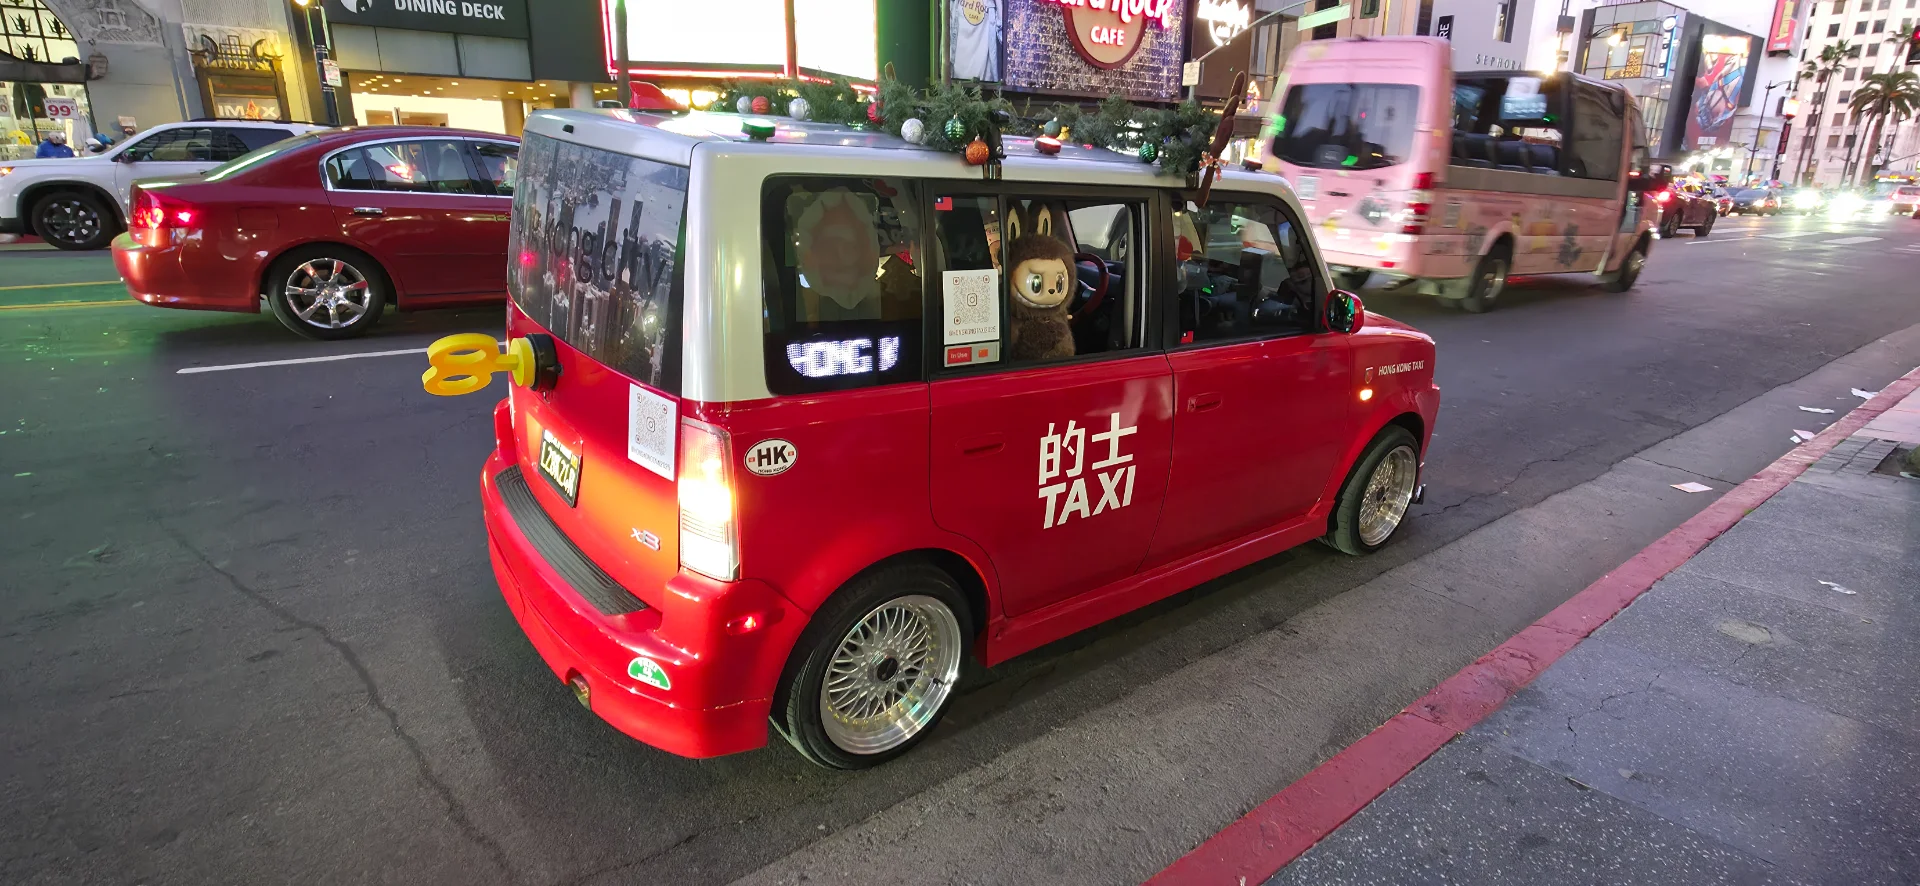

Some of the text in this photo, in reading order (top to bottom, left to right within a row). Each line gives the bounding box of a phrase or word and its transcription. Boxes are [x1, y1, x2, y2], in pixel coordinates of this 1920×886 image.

[394, 0, 505, 20] DINING DECK
[1090, 26, 1124, 45] CAFE
[1475, 53, 1522, 70] SEPHORA
[217, 99, 278, 119] IMX
[1378, 360, 1424, 376] HONG KONG TAXI
[757, 444, 788, 467] HK
[1039, 412, 1137, 485] 的士
[1039, 465, 1136, 529] TAXI
